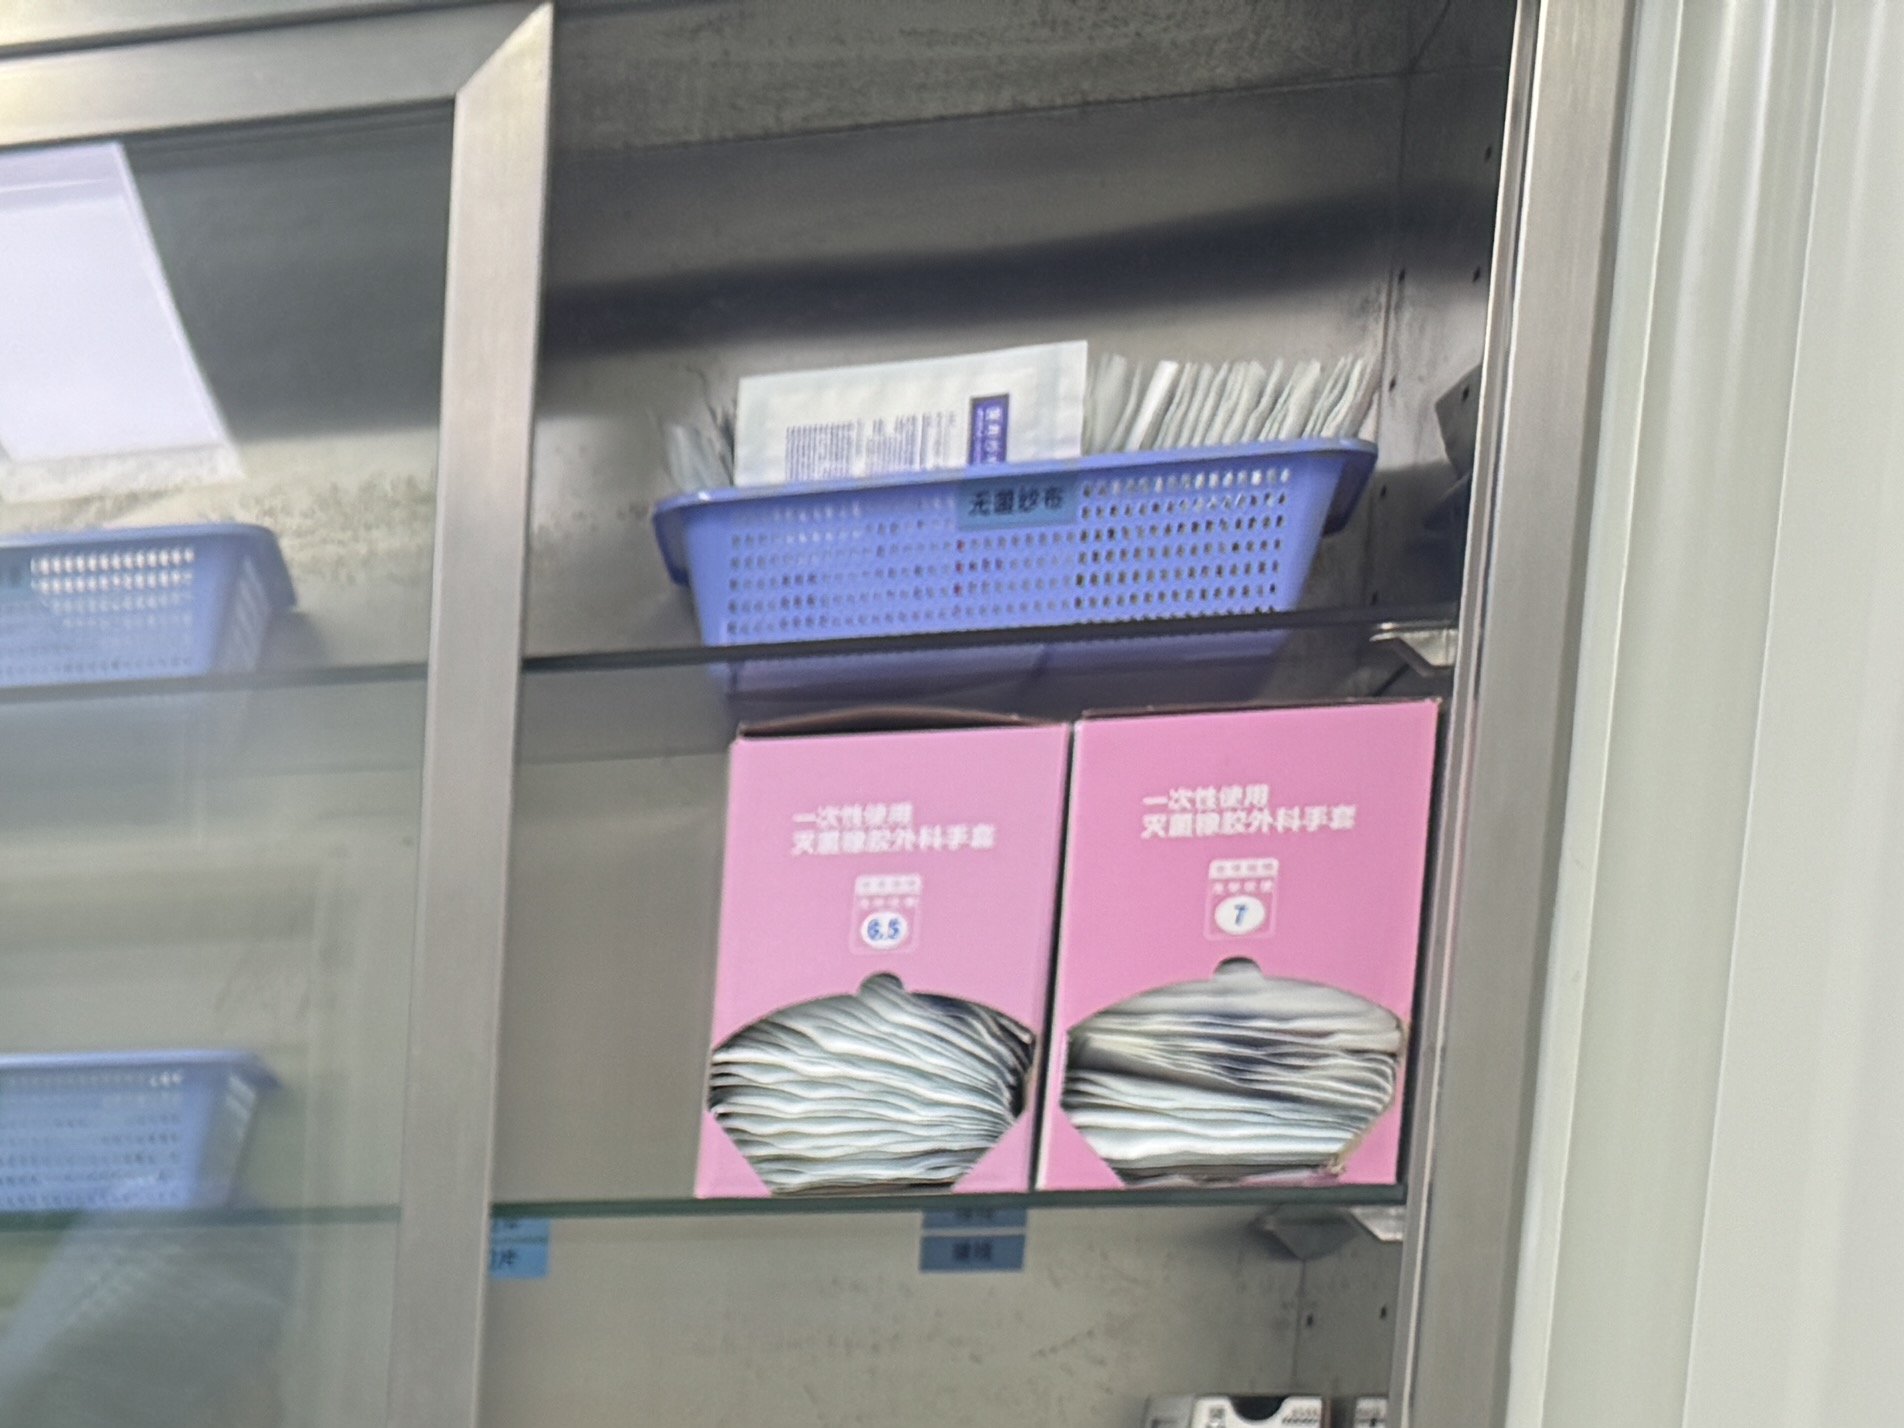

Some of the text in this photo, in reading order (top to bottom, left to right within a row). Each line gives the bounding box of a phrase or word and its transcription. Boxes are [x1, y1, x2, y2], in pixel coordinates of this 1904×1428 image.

[968, 486, 1063, 517] 无菌纱布
[1142, 783, 1269, 810] 一次性使用
[792, 802, 913, 828] 一次性使用
[1140, 805, 1356, 839] 灭菌橡胶外科手套
[1233, 903, 1249, 926] 7
[867, 917, 901, 941] 6.5
